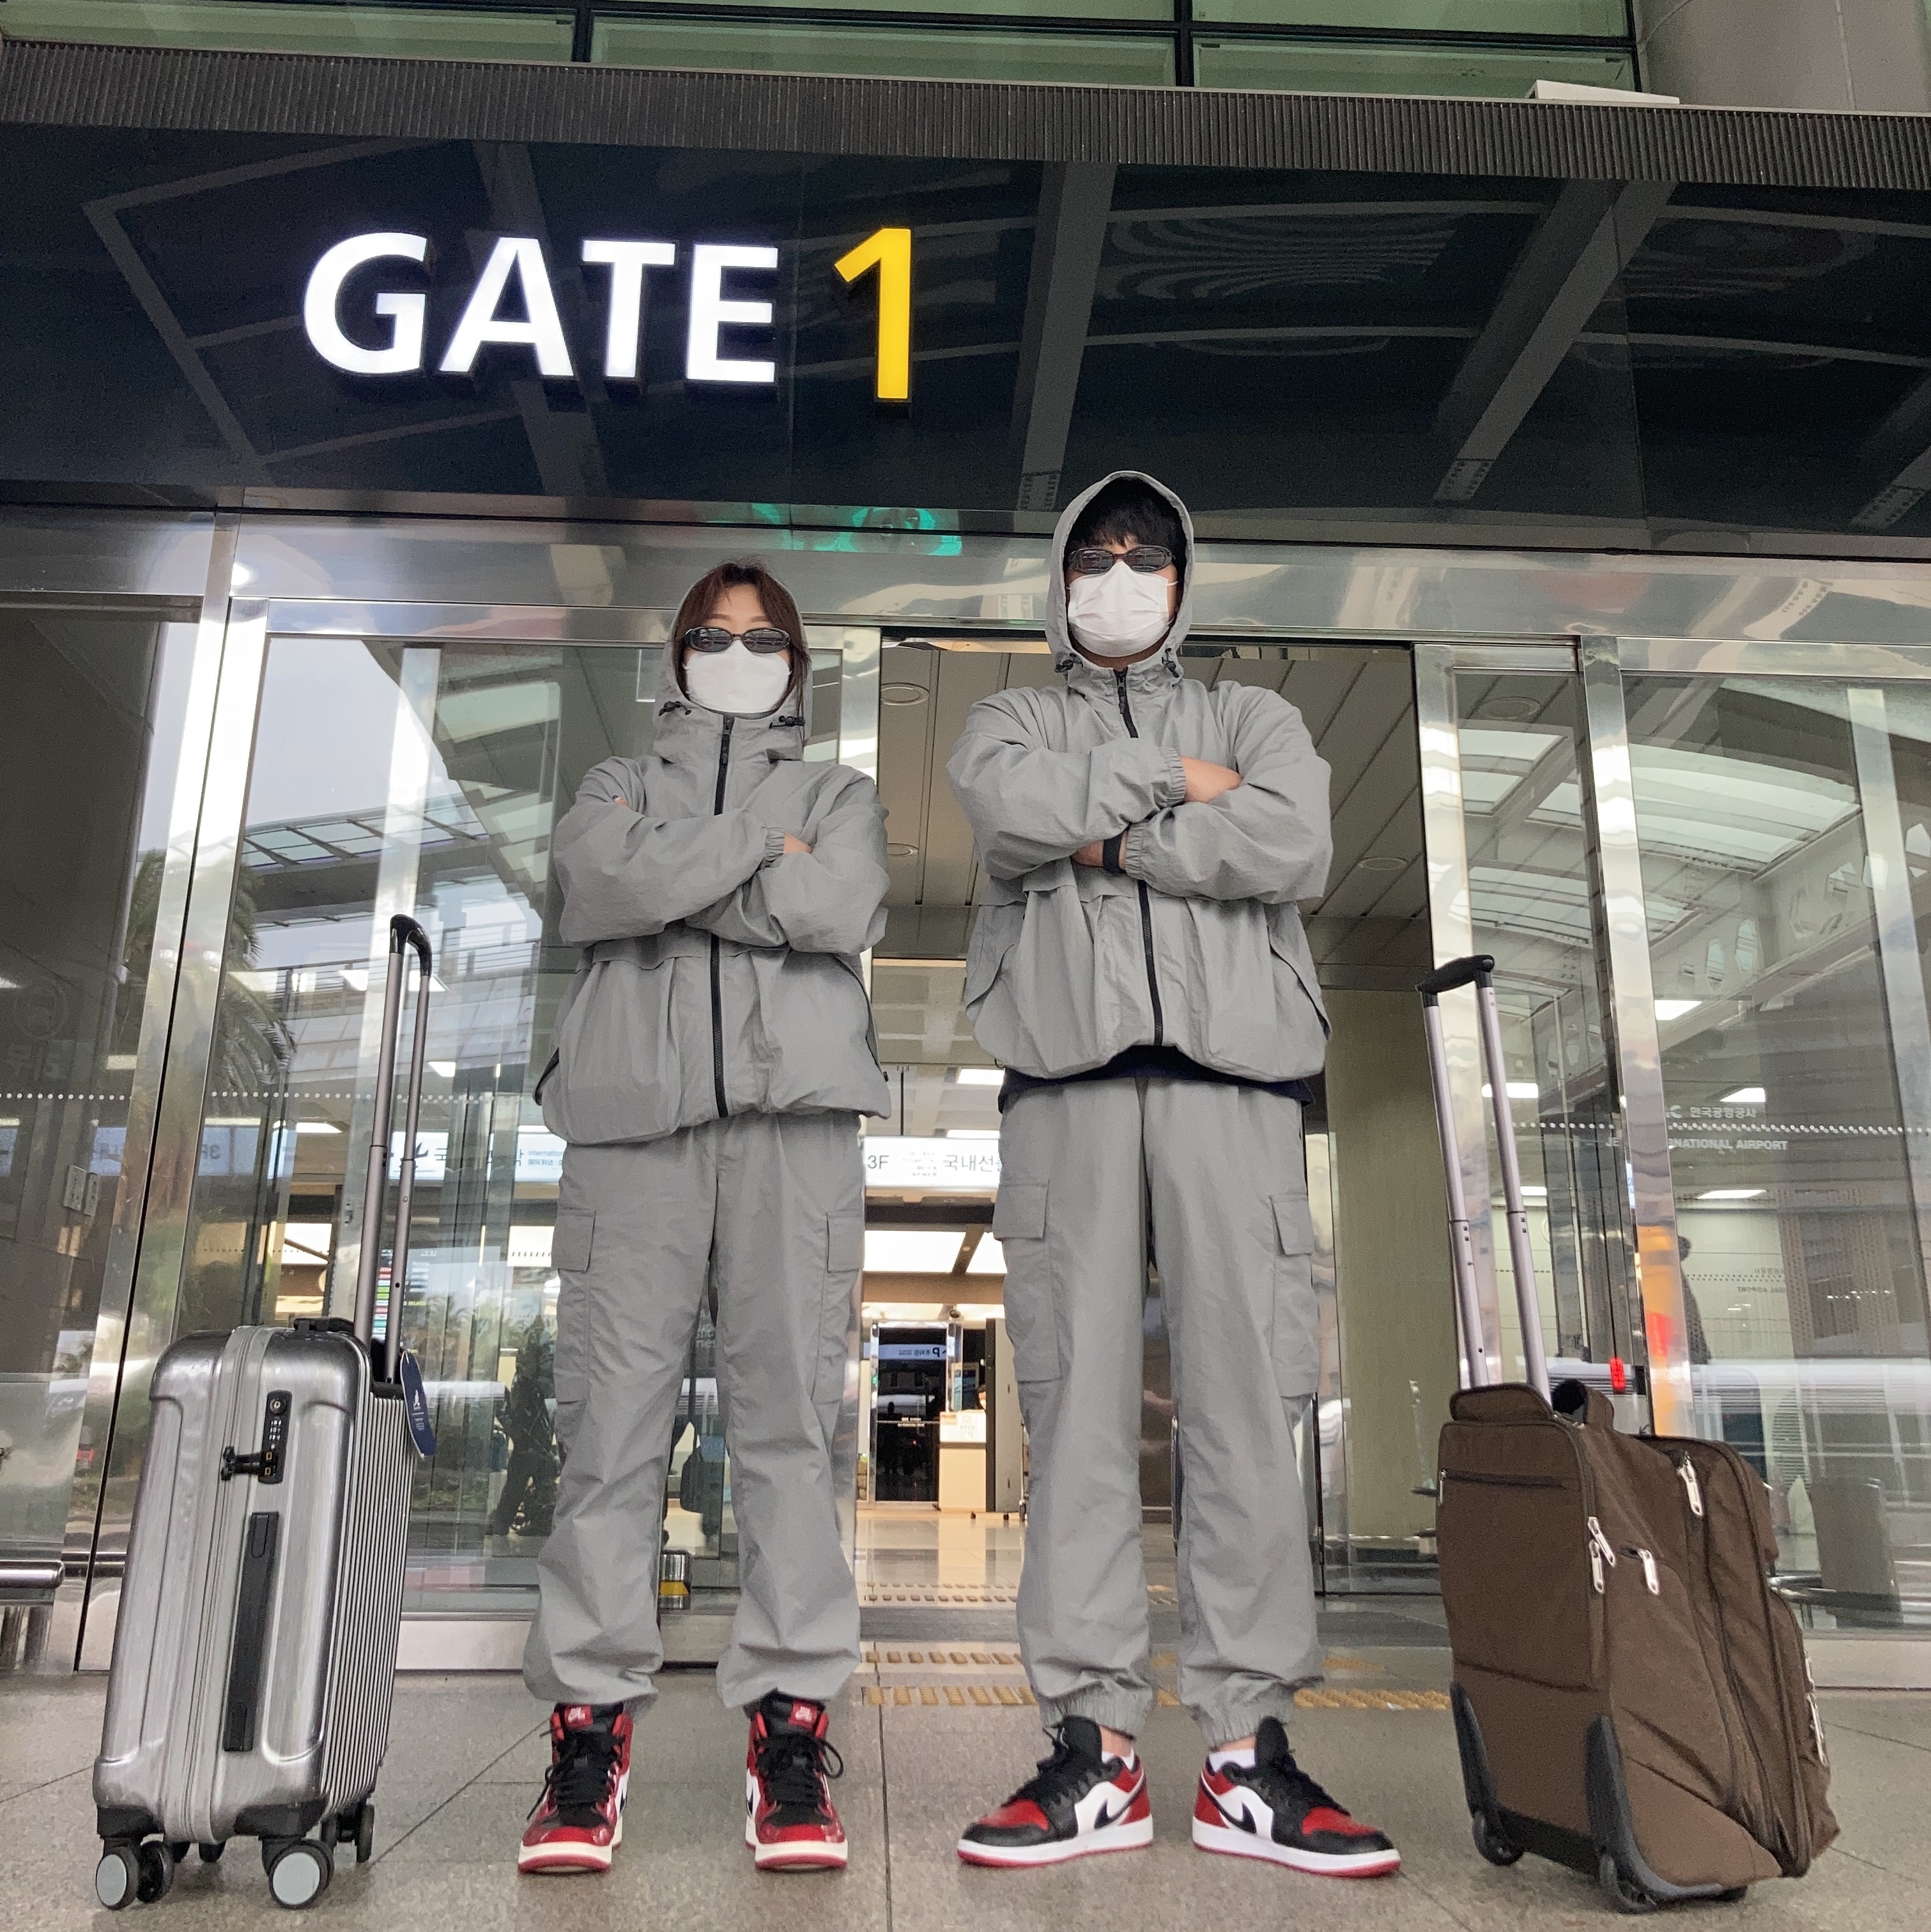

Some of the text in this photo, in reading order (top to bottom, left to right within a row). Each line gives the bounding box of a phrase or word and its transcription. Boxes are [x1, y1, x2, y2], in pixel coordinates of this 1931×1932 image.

[304, 228, 912, 399] GATE 1
[1689, 1106, 1757, 1119] 한국공항공사
[1735, 1140, 1789, 1150] AIRPORT
[867, 1155, 889, 1170] 3F
